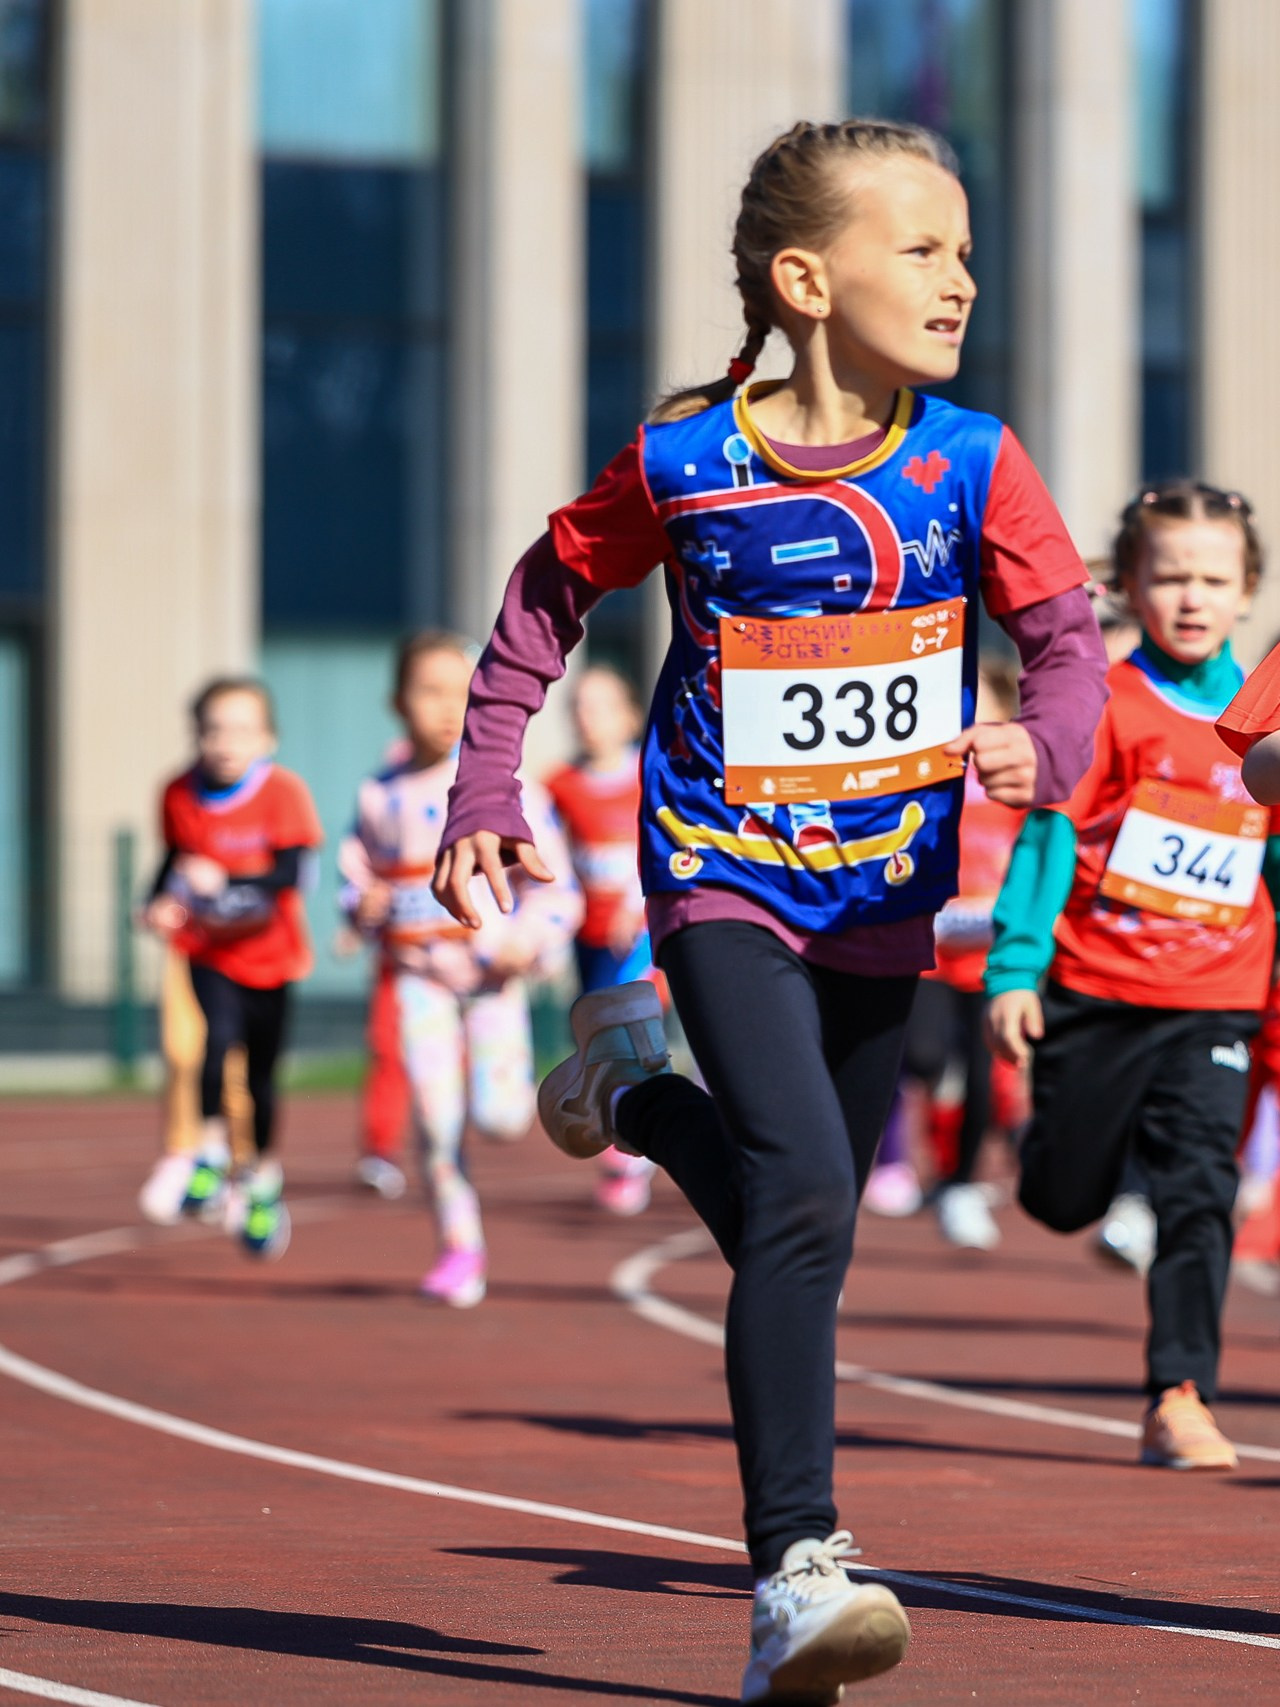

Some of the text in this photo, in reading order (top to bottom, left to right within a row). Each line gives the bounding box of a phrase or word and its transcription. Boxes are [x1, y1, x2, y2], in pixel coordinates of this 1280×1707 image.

[741, 620, 851, 646] ДЕТСКИЙ
[911, 626, 949, 655] 6-7
[782, 675, 918, 750] 338
[1153, 834, 1235, 889] 344
